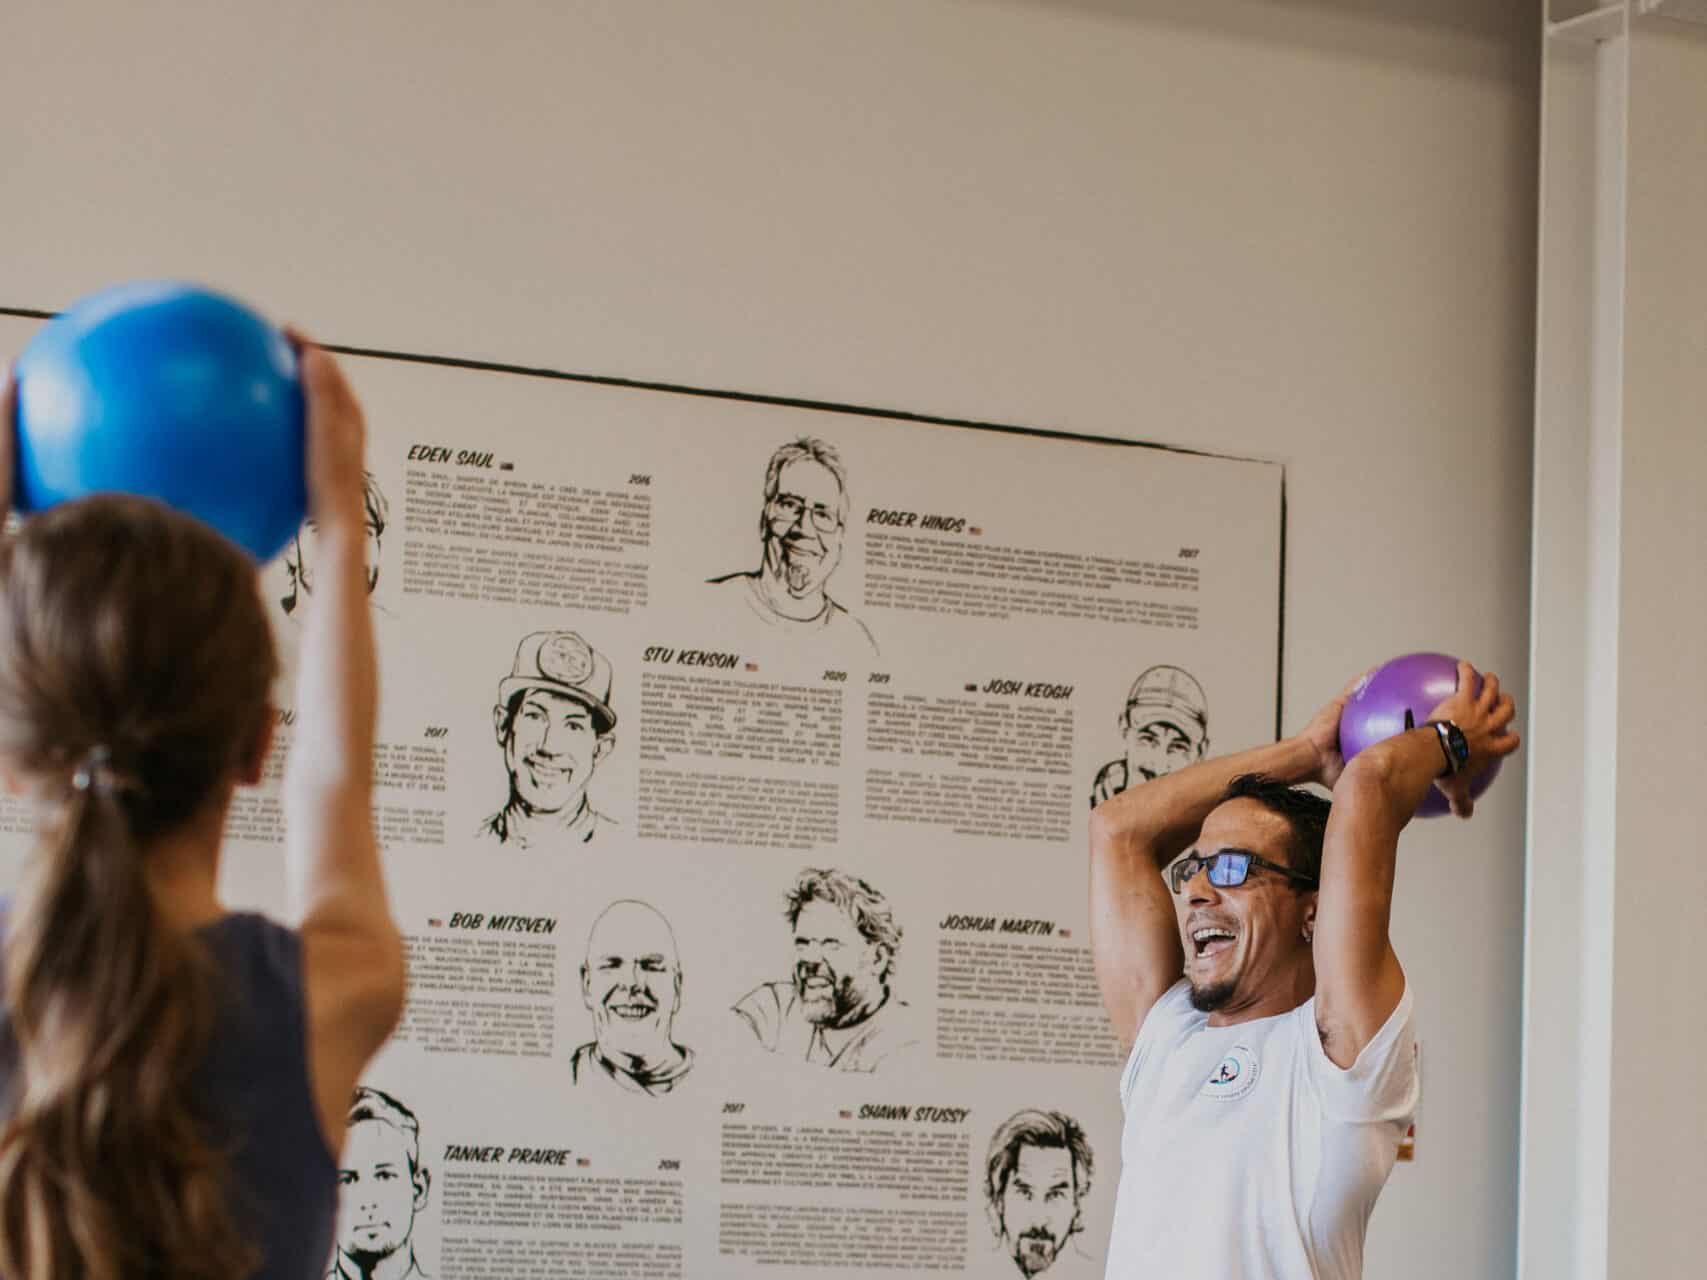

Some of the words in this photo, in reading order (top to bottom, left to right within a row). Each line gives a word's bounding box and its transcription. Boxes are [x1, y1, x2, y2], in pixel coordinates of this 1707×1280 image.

[407, 445, 452, 463] EDEN
[455, 450, 494, 468] SAUL
[865, 508, 918, 528] ROGER
[920, 514, 966, 533] HINDS
[642, 646, 674, 663] STU
[676, 650, 739, 669] KENSON
[822, 670, 847, 682] 2020
[982, 679, 1022, 696] JOSH
[1024, 682, 1075, 700] KEOGH
[424, 727, 448, 737] 2017
[449, 912, 484, 929] BOB
[487, 915, 557, 934] MITSVEN
[939, 914, 996, 932] JOSHUA
[999, 919, 1055, 936] MARTIN
[722, 1103, 745, 1113] 2017
[858, 1104, 911, 1121] SHAWN
[913, 1106, 971, 1123] STUSSY
[443, 1145, 504, 1162] TANNER
[508, 1148, 571, 1166] PRAIRIE
